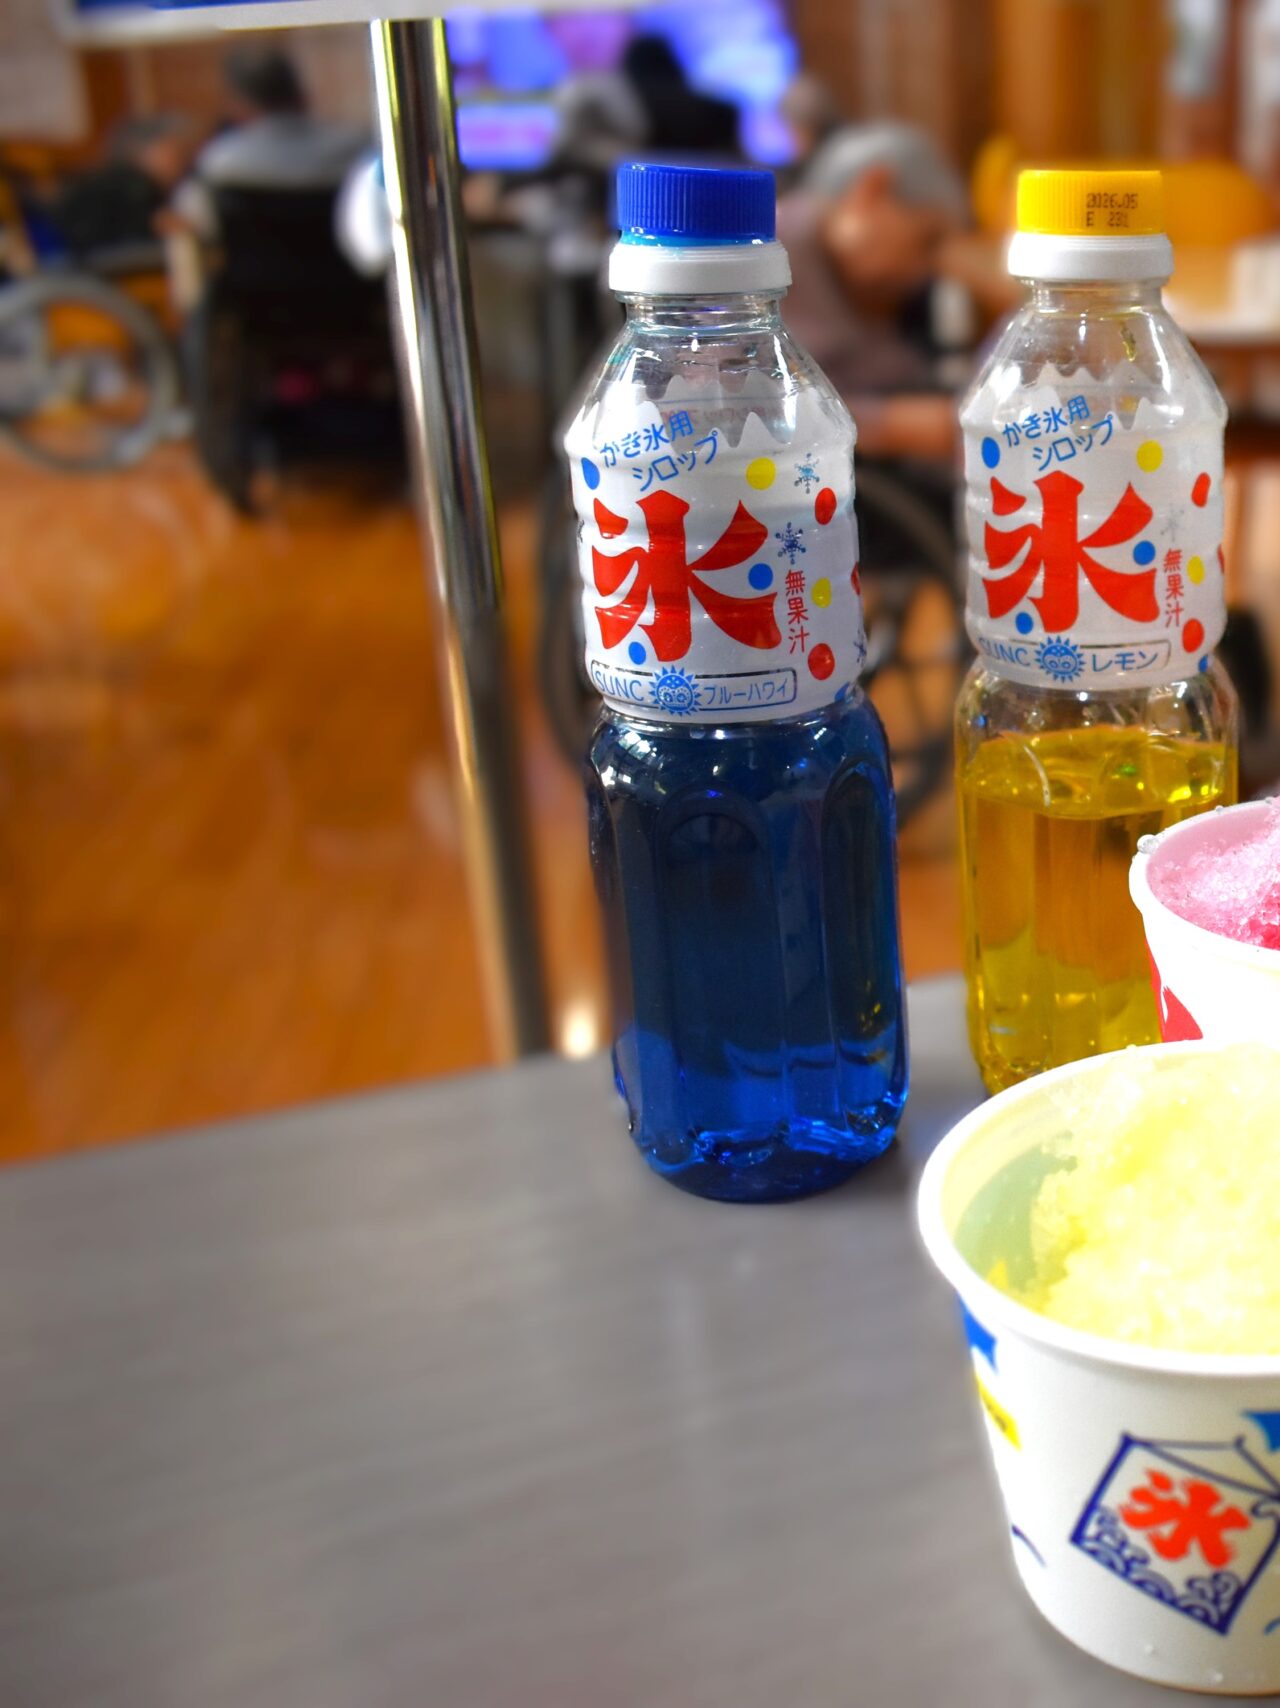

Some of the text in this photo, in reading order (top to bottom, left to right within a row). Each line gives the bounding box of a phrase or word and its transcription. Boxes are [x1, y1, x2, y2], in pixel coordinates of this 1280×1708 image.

[1002, 395, 1090, 448] かき氷用
[1032, 414, 1113, 471] シロップ
[632, 430, 718, 492] シロップ
[592, 489, 782, 662] 氷
[982, 470, 1160, 633] 氷
[784, 569, 810, 654] 無果汁
[1163, 548, 1185, 629] 無果汁
[594, 670, 644, 702] SUNC
[1092, 651, 1158, 673] レモン
[1118, 1468, 1252, 1569] 氷
